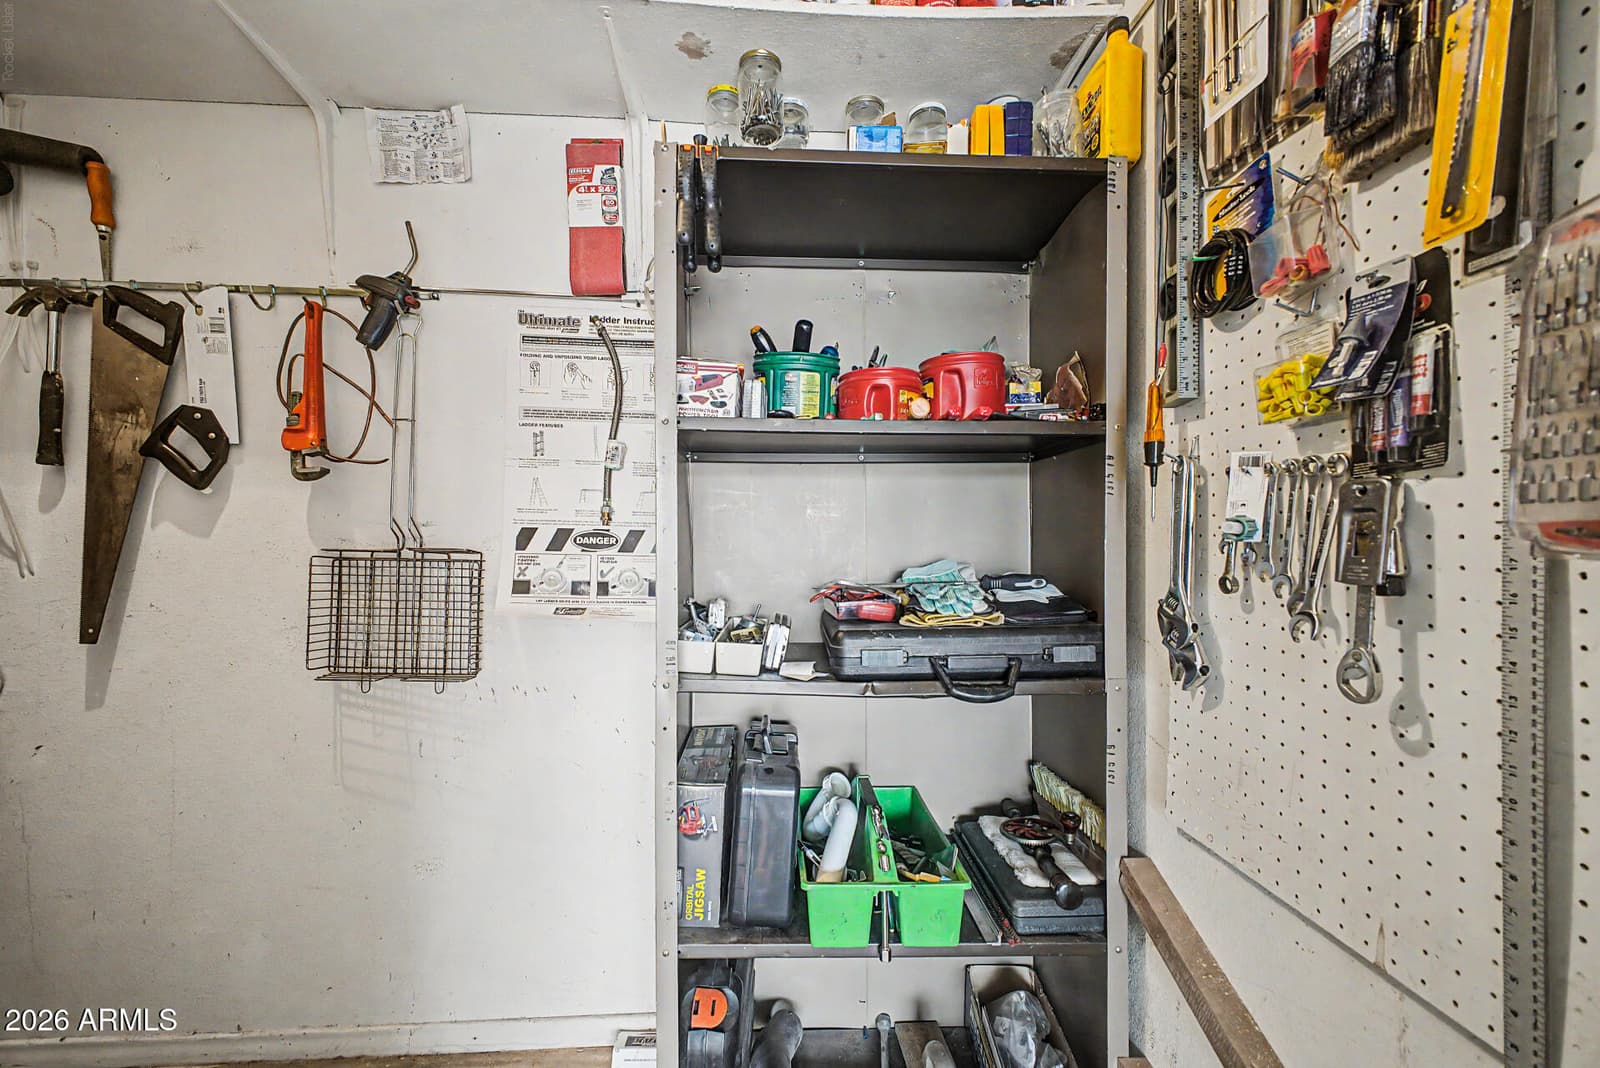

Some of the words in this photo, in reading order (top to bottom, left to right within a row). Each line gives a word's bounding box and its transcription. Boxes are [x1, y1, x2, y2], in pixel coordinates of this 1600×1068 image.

[518, 312, 581, 327] Ultimate
[589, 315, 621, 324] Ldder
[575, 536, 617, 545] DANGER
[1508, 557, 1518, 571] 17
[1508, 593, 1518, 605] 16
[1508, 627, 1518, 640] 15
[1508, 660, 1518, 674] 14
[1508, 695, 1518, 709] 13
[694, 868, 706, 921] JIGSAW
[685, 884, 695, 920] ORBITAL
